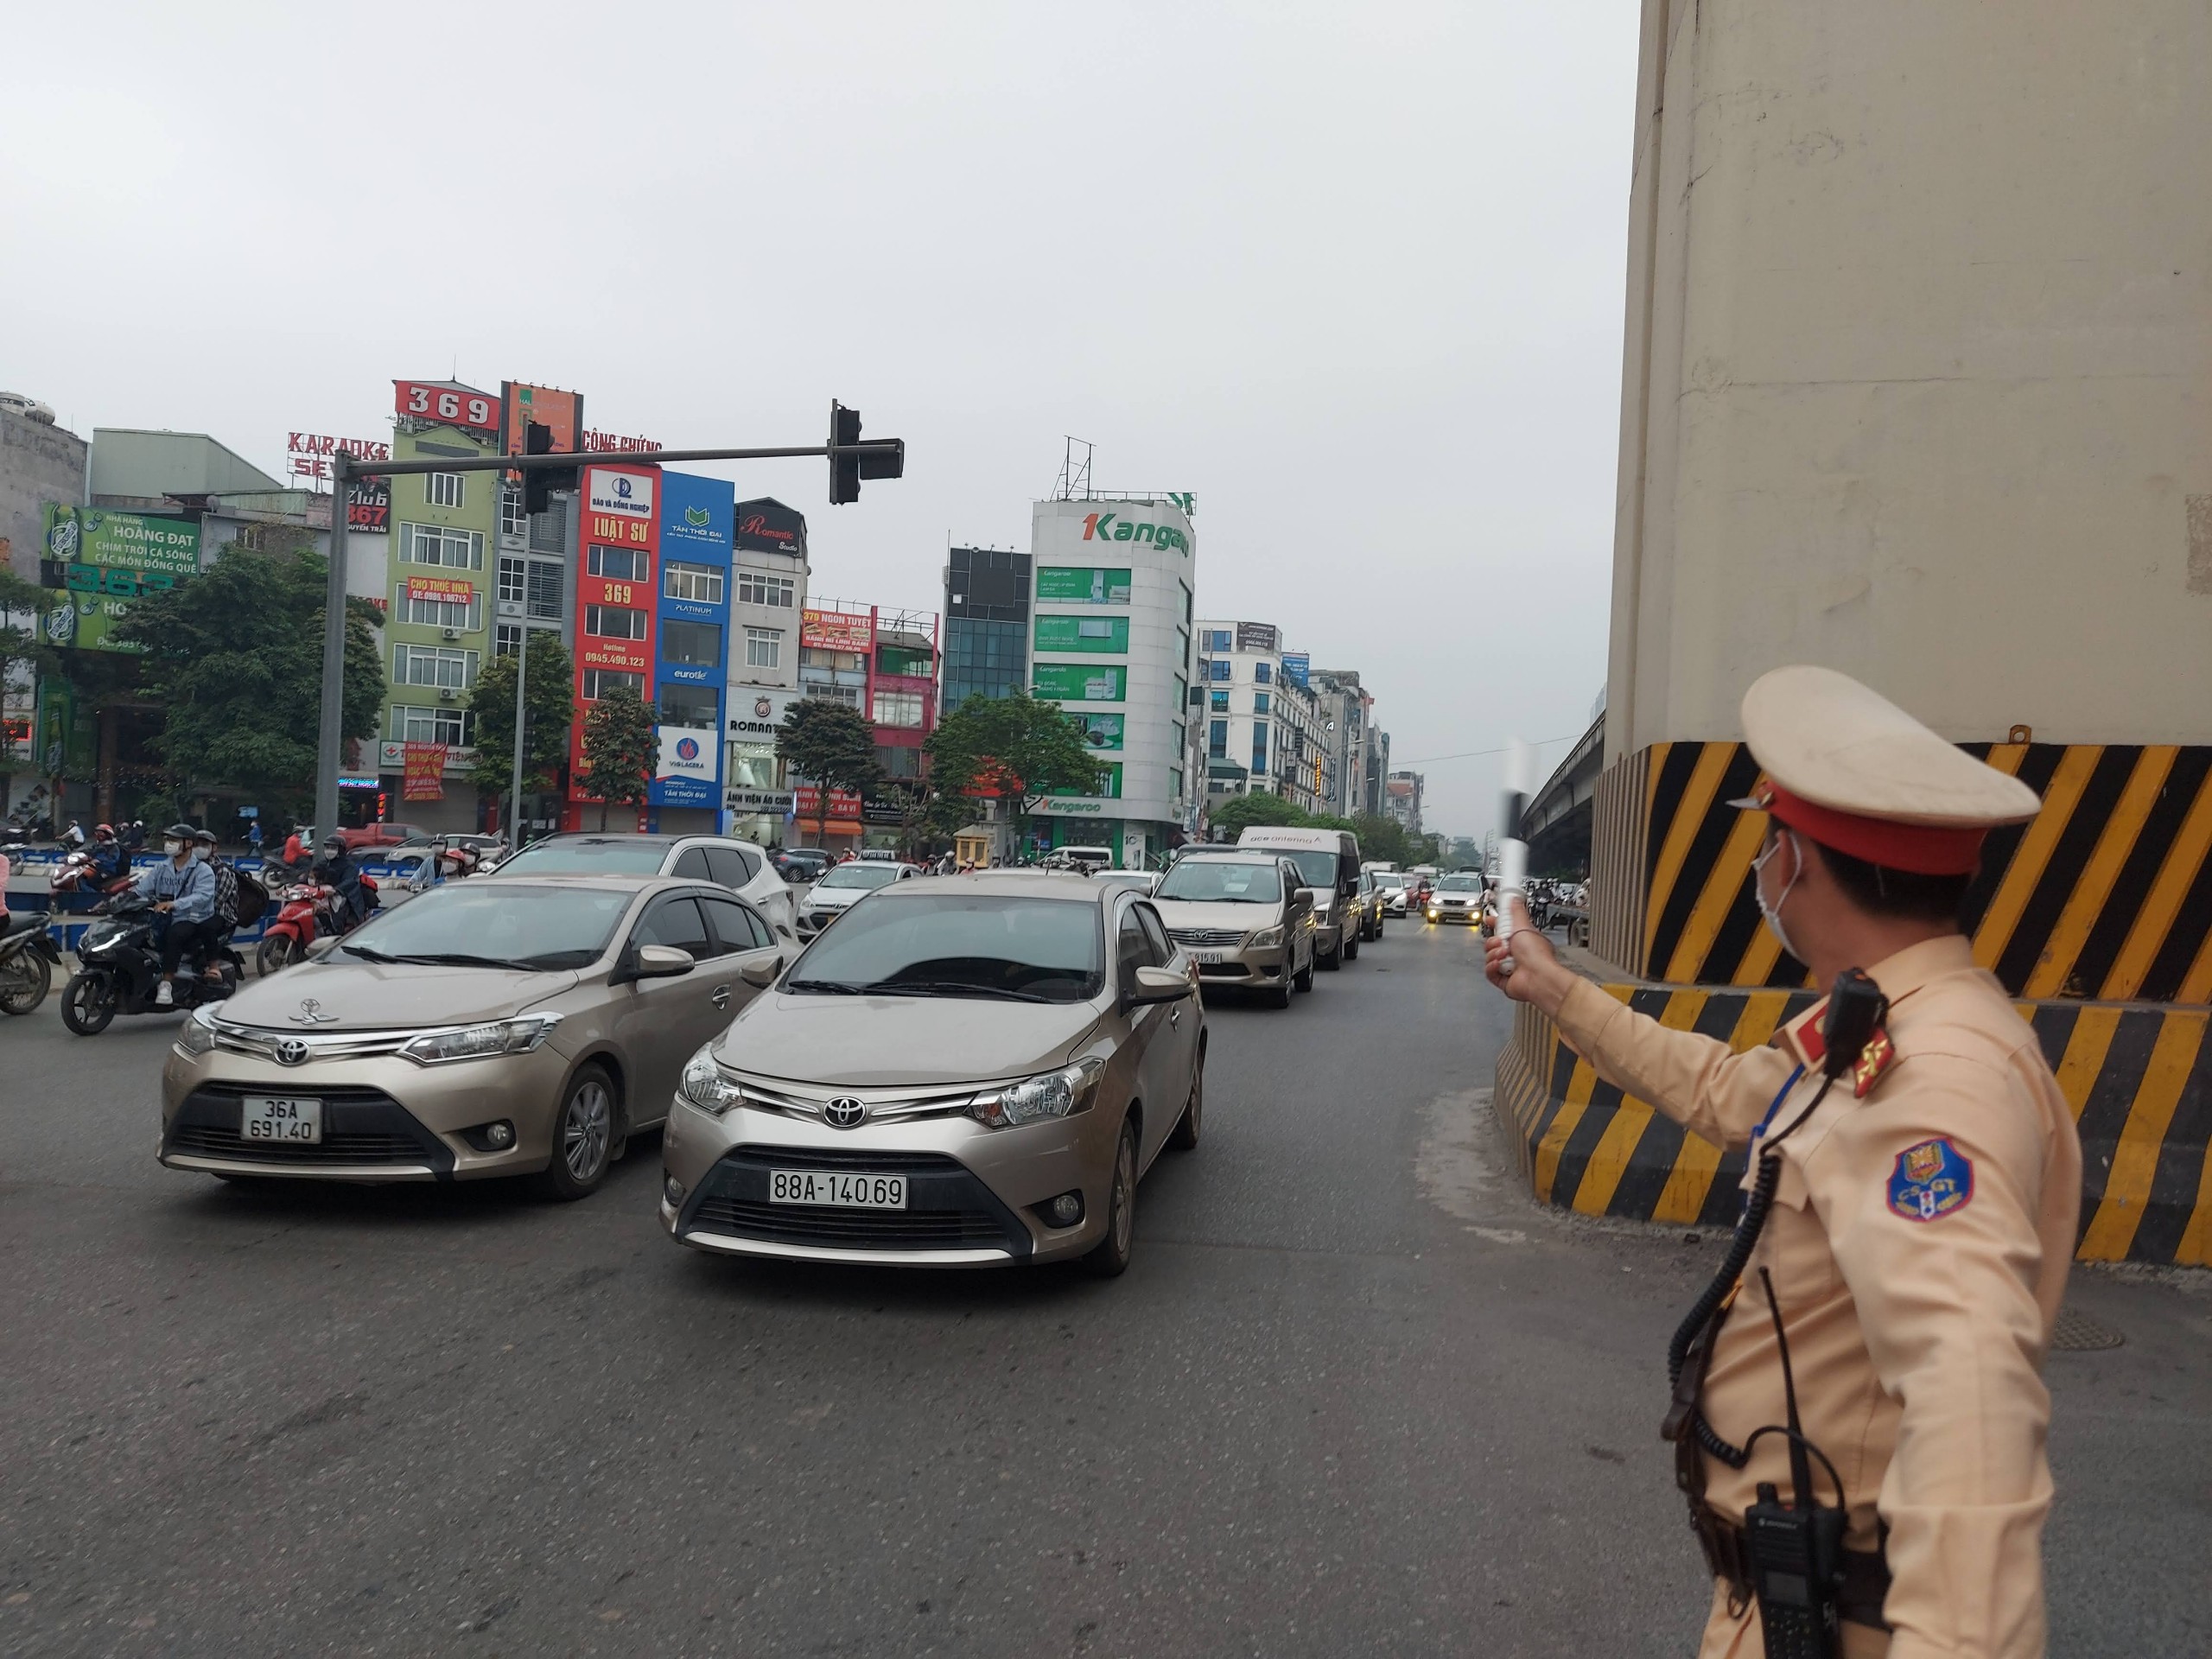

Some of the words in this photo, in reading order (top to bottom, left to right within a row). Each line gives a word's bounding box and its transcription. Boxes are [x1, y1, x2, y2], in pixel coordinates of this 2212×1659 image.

[409, 387, 489, 423] 369
[289, 433, 389, 461] KARAOKE
[582, 428, 616, 452] CÔNG
[113, 525, 164, 543] HOÀNG
[168, 532, 194, 549] ĐẠT
[594, 516, 625, 543] LUẬT
[631, 522, 649, 543] SƯ
[740, 514, 794, 540] Romantic
[96, 542, 122, 552] CHIM
[124, 544, 147, 555] TRỜI
[149, 547, 163, 557] CÁ
[166, 550, 194, 562] SÔNG
[118, 555, 141, 566] MÓN
[410, 579, 428, 589] CHO
[604, 582, 632, 604] 369
[822, 613, 845, 625] NGON
[1042, 798, 1102, 813] Kangaroo
[264, 1100, 297, 1119] 36A
[251, 1120, 311, 1139] 691.40
[774, 1173, 902, 1205] 88A-140.69
